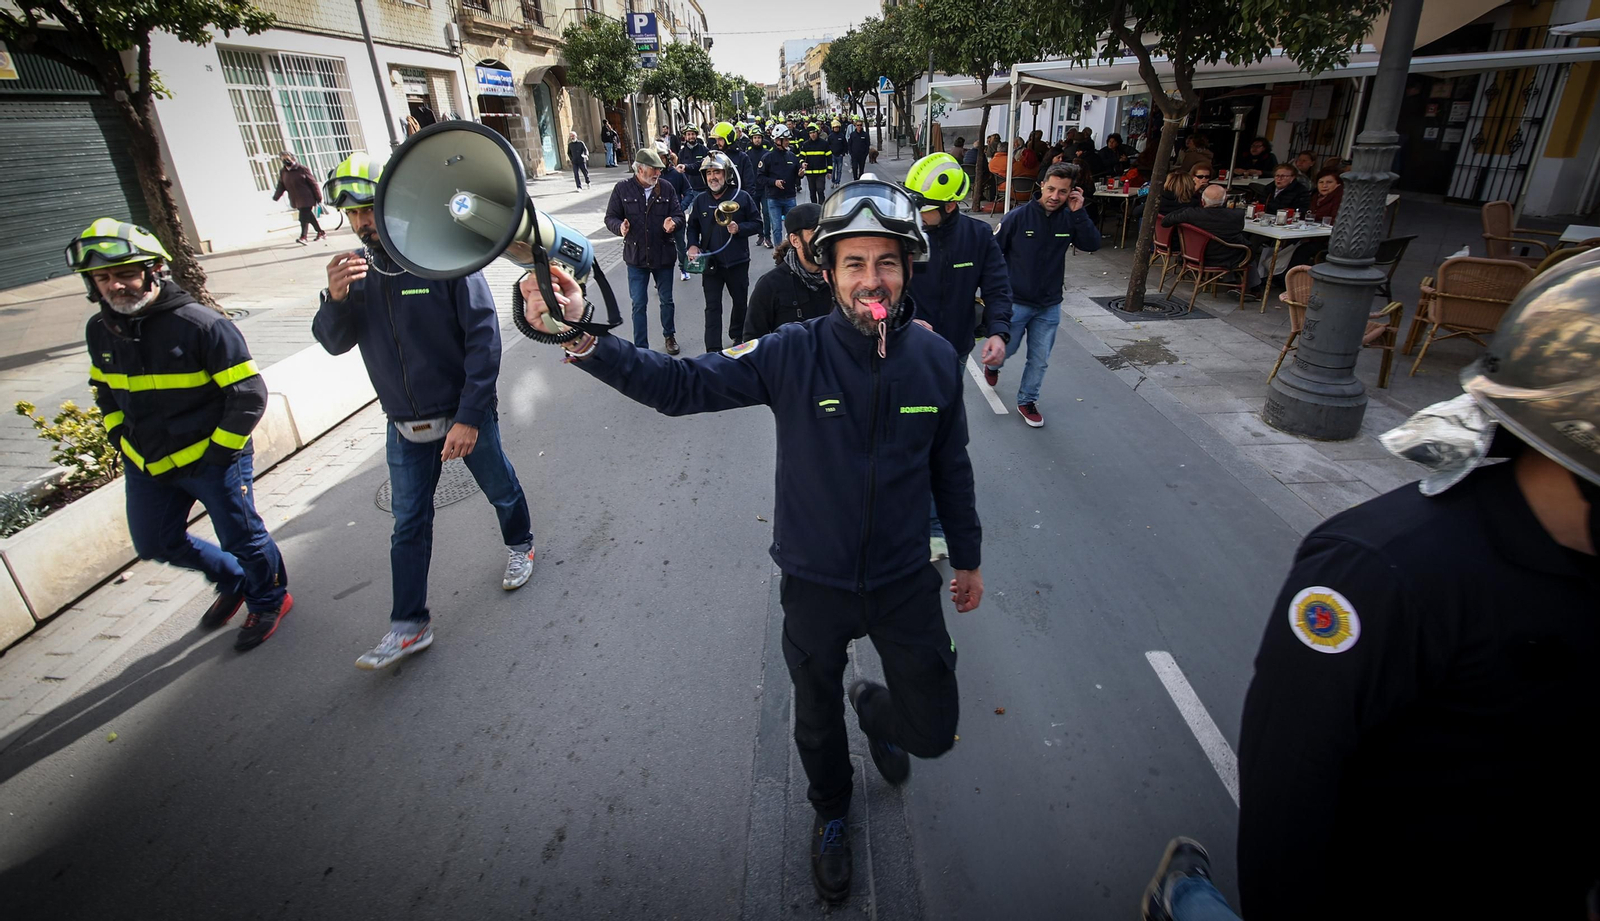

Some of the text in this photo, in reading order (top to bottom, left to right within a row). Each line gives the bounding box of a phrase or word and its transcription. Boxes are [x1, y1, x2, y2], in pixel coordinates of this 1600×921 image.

[634, 14, 649, 34] P
[477, 68, 485, 83] P
[401, 287, 430, 296] BOMBEROS
[900, 405, 939, 414] BOMBEROS
